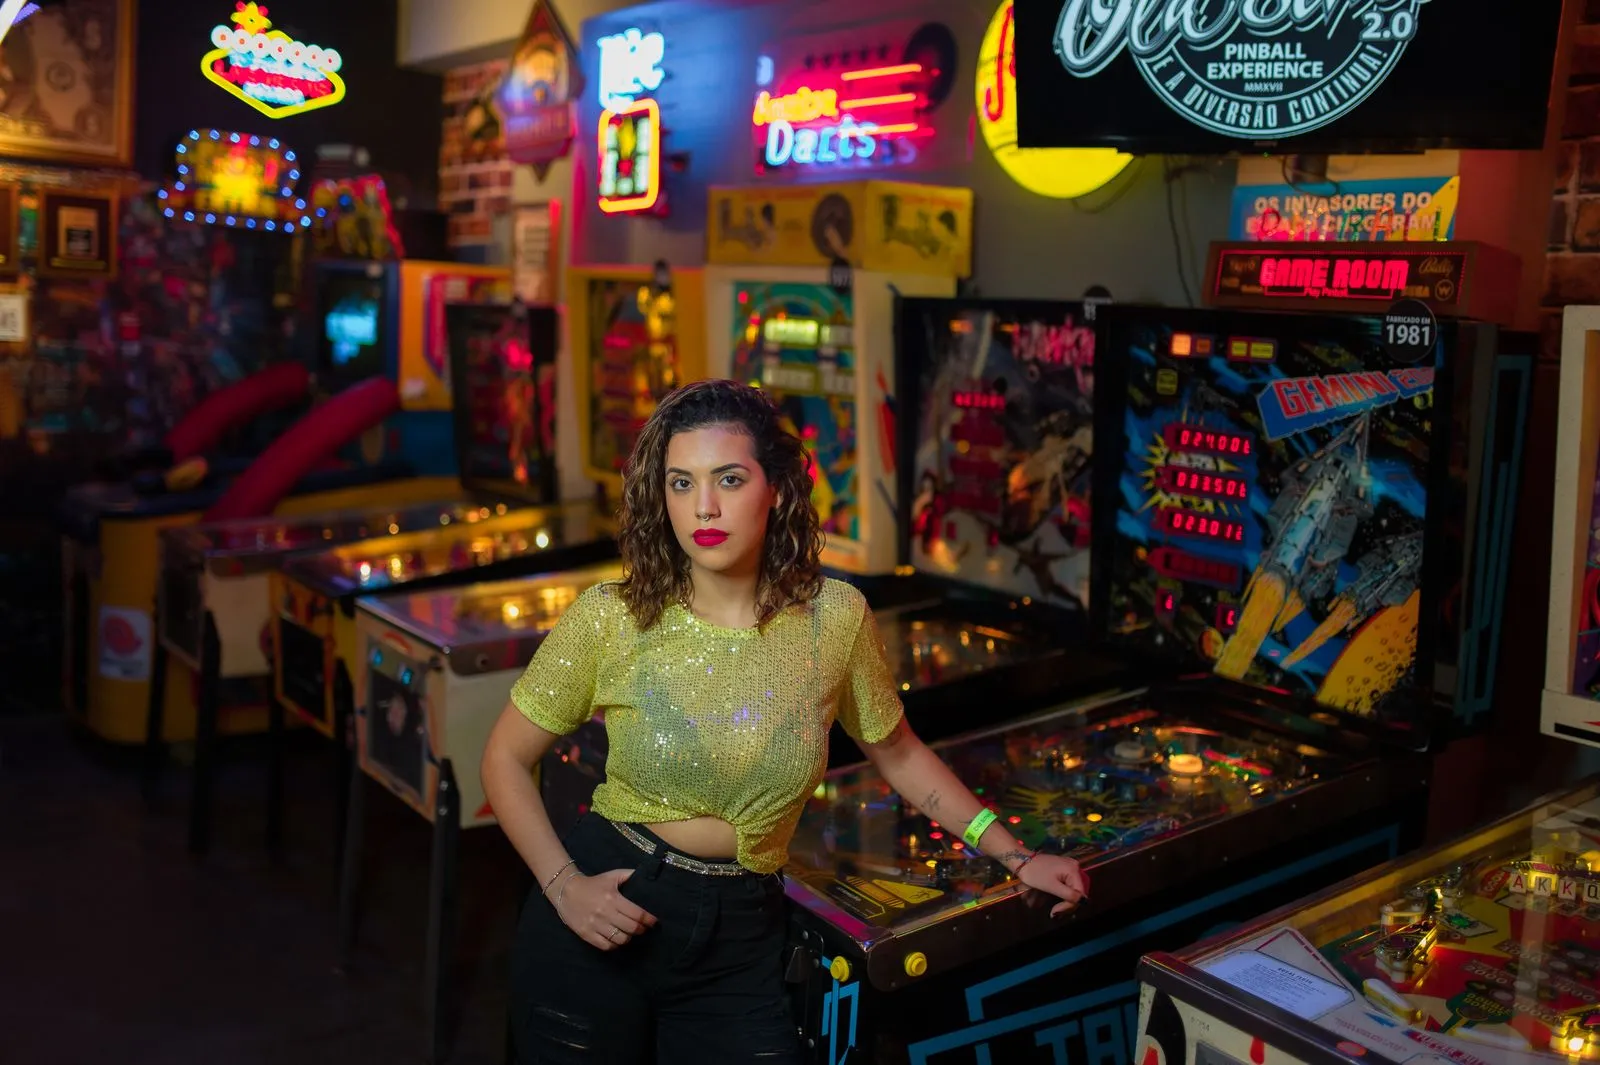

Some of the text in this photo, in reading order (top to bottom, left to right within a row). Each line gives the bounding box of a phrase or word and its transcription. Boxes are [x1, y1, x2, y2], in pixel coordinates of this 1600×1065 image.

[1361, 10, 1415, 39] 2.0
[1225, 43, 1307, 60] PINBALL
[1207, 62, 1324, 79] EXPERIENCE
[1152, 44, 1388, 128] E A DIVERSÃO CONTINUA!
[1244, 81, 1284, 93] MMXVII
[1255, 192, 1433, 212] OS INVASORES DO
[1259, 257, 1409, 290] GAME ROOM
[1386, 315, 1431, 325] FABRICADO EM
[1386, 323, 1431, 346] 1981
[1272, 370, 1399, 419] GEMINI
[1512, 875, 1524, 889] A
[1538, 878, 1548, 892] K
[1562, 880, 1573, 896] K
[1587, 884, 1600, 900] Q
